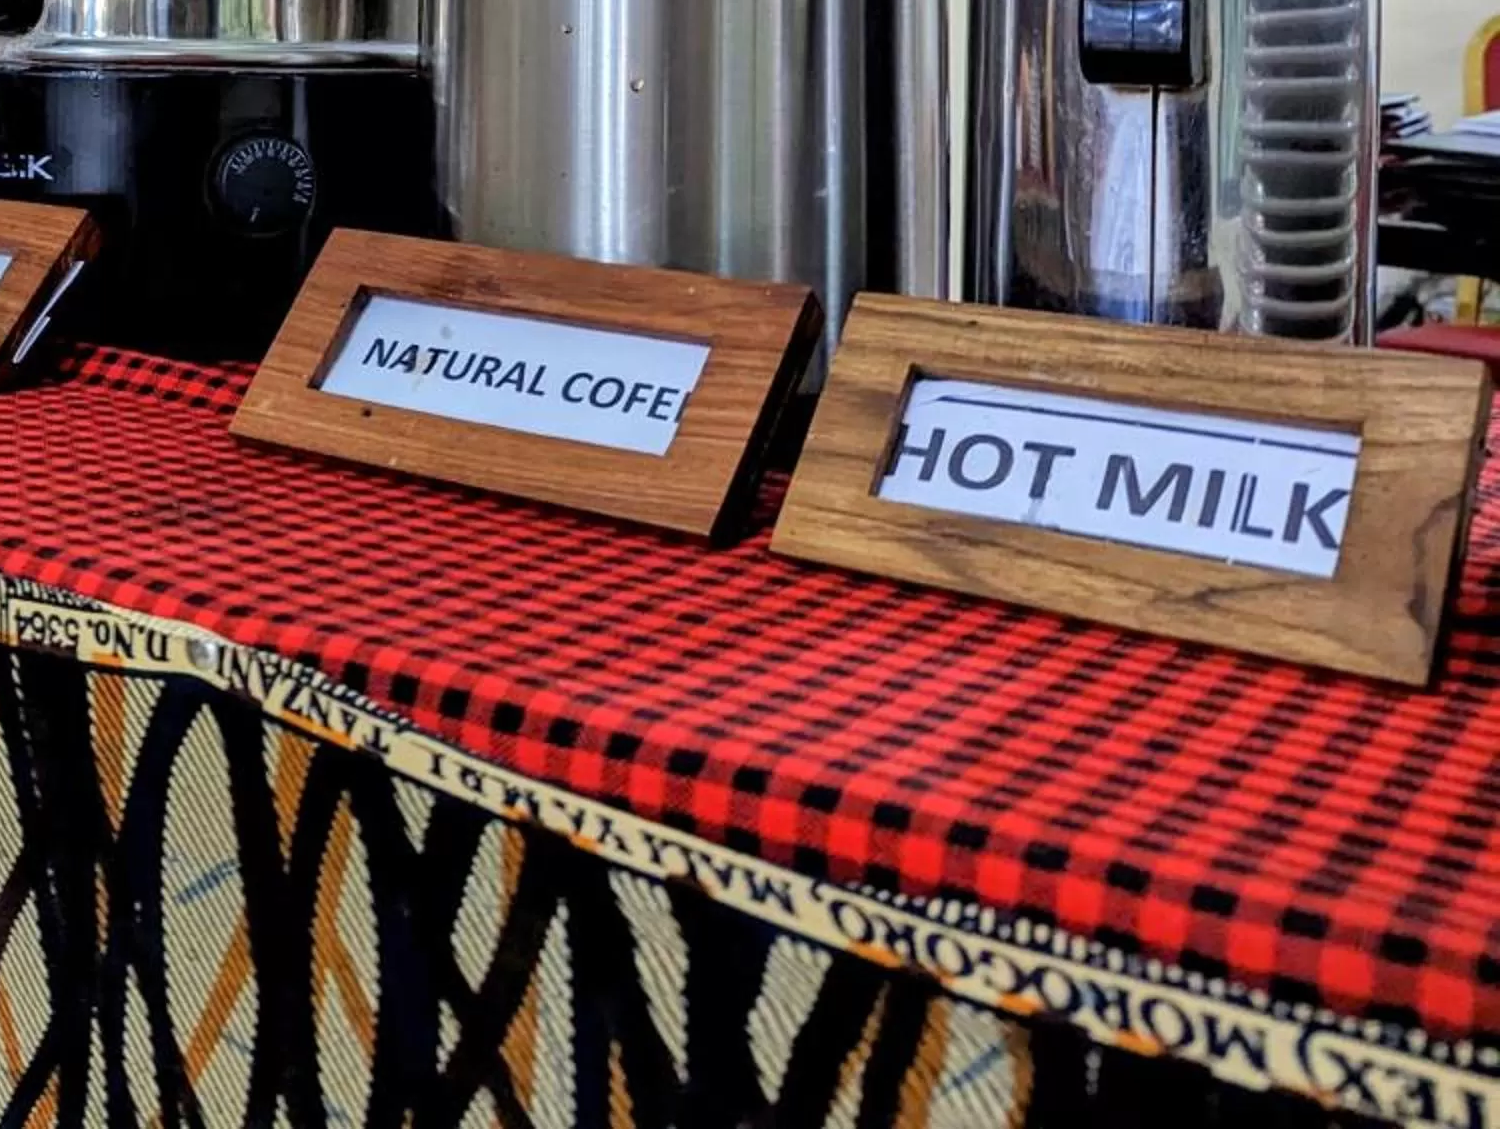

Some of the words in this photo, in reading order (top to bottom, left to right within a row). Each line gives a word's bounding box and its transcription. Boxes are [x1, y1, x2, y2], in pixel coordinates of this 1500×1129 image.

[362, 337, 547, 397] NATURAL
[885, 423, 1076, 501] HOT
[1095, 453, 1350, 551] MILK
[13, 606, 79, 649] 5364
[217, 646, 389, 754] TANZANI
[808, 880, 1269, 1074] MOROGORO,
